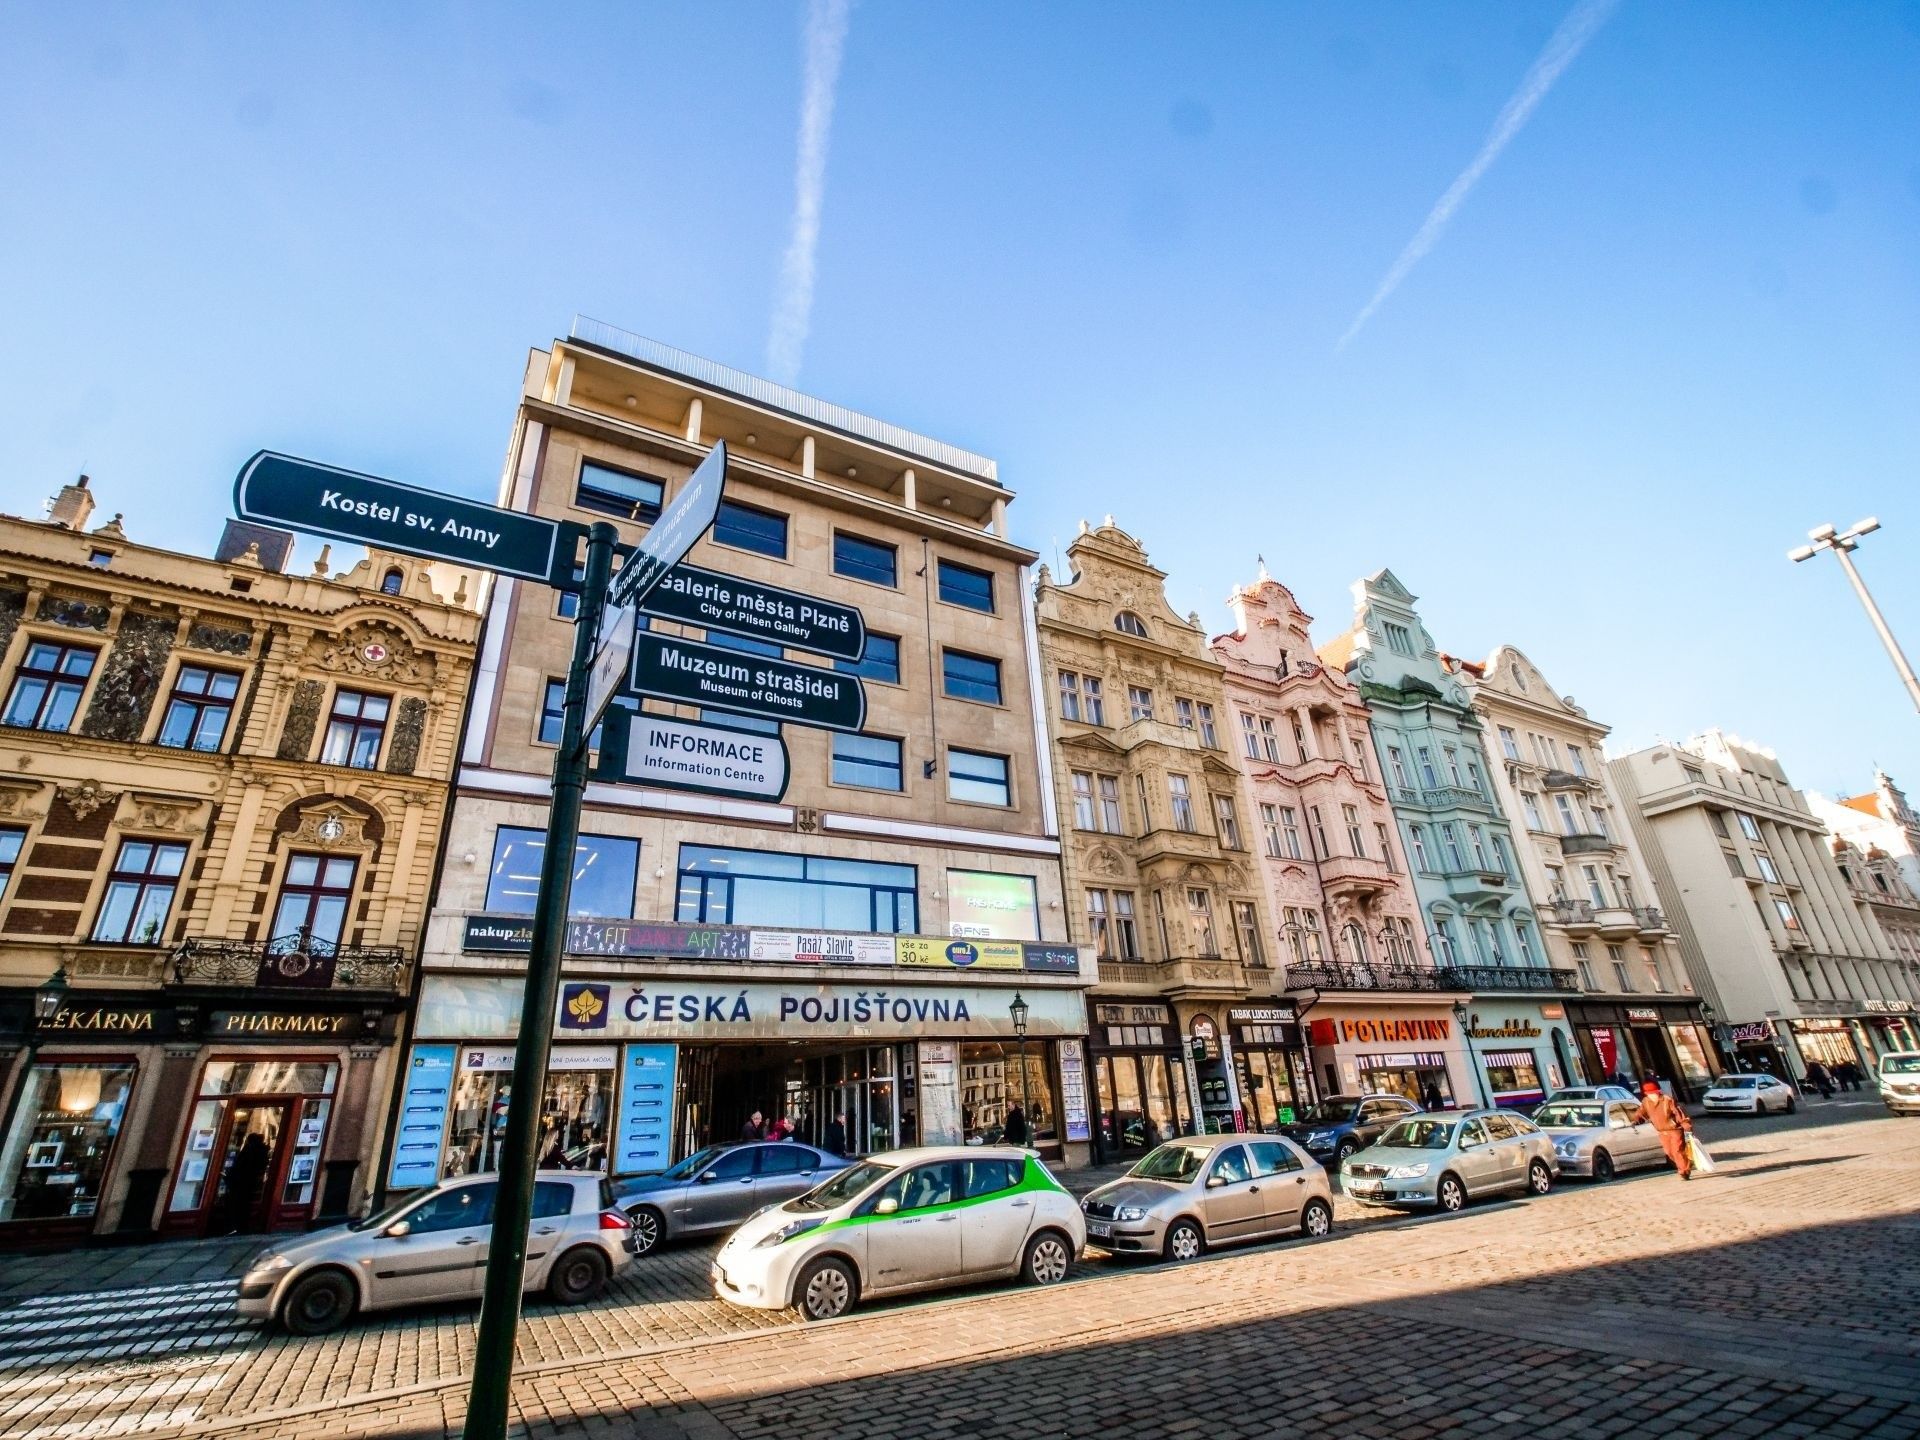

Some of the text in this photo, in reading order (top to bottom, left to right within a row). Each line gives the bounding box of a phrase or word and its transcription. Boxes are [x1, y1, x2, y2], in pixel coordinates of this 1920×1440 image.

[320, 489, 501, 549] Kostel sv. Anny
[659, 573, 850, 633] Galerie města Plzně
[700, 603, 811, 639] City of Pilsen Gallery
[660, 647, 840, 700] Muzeum strašidel
[701, 679, 804, 709] Museum of Ghosts
[649, 730, 764, 764] INFORMACE
[644, 755, 765, 783] Information Centre
[469, 926, 533, 941] nakupzla
[796, 935, 822, 954] Pasáž
[827, 938, 853, 955] Slavie
[901, 940, 915, 949] vše
[901, 952, 917, 963] 30
[920, 955, 929, 964] kč
[624, 988, 971, 1023] ČESKÁ POJIŠŤOVNA
[1230, 1009, 1294, 1019] TABAK LUCKY STRIKE
[1863, 1000, 1887, 1011] HOTEL
[226, 1011, 345, 1032] PHARMACY
[1340, 1019, 1450, 1042] POTRAVINY
